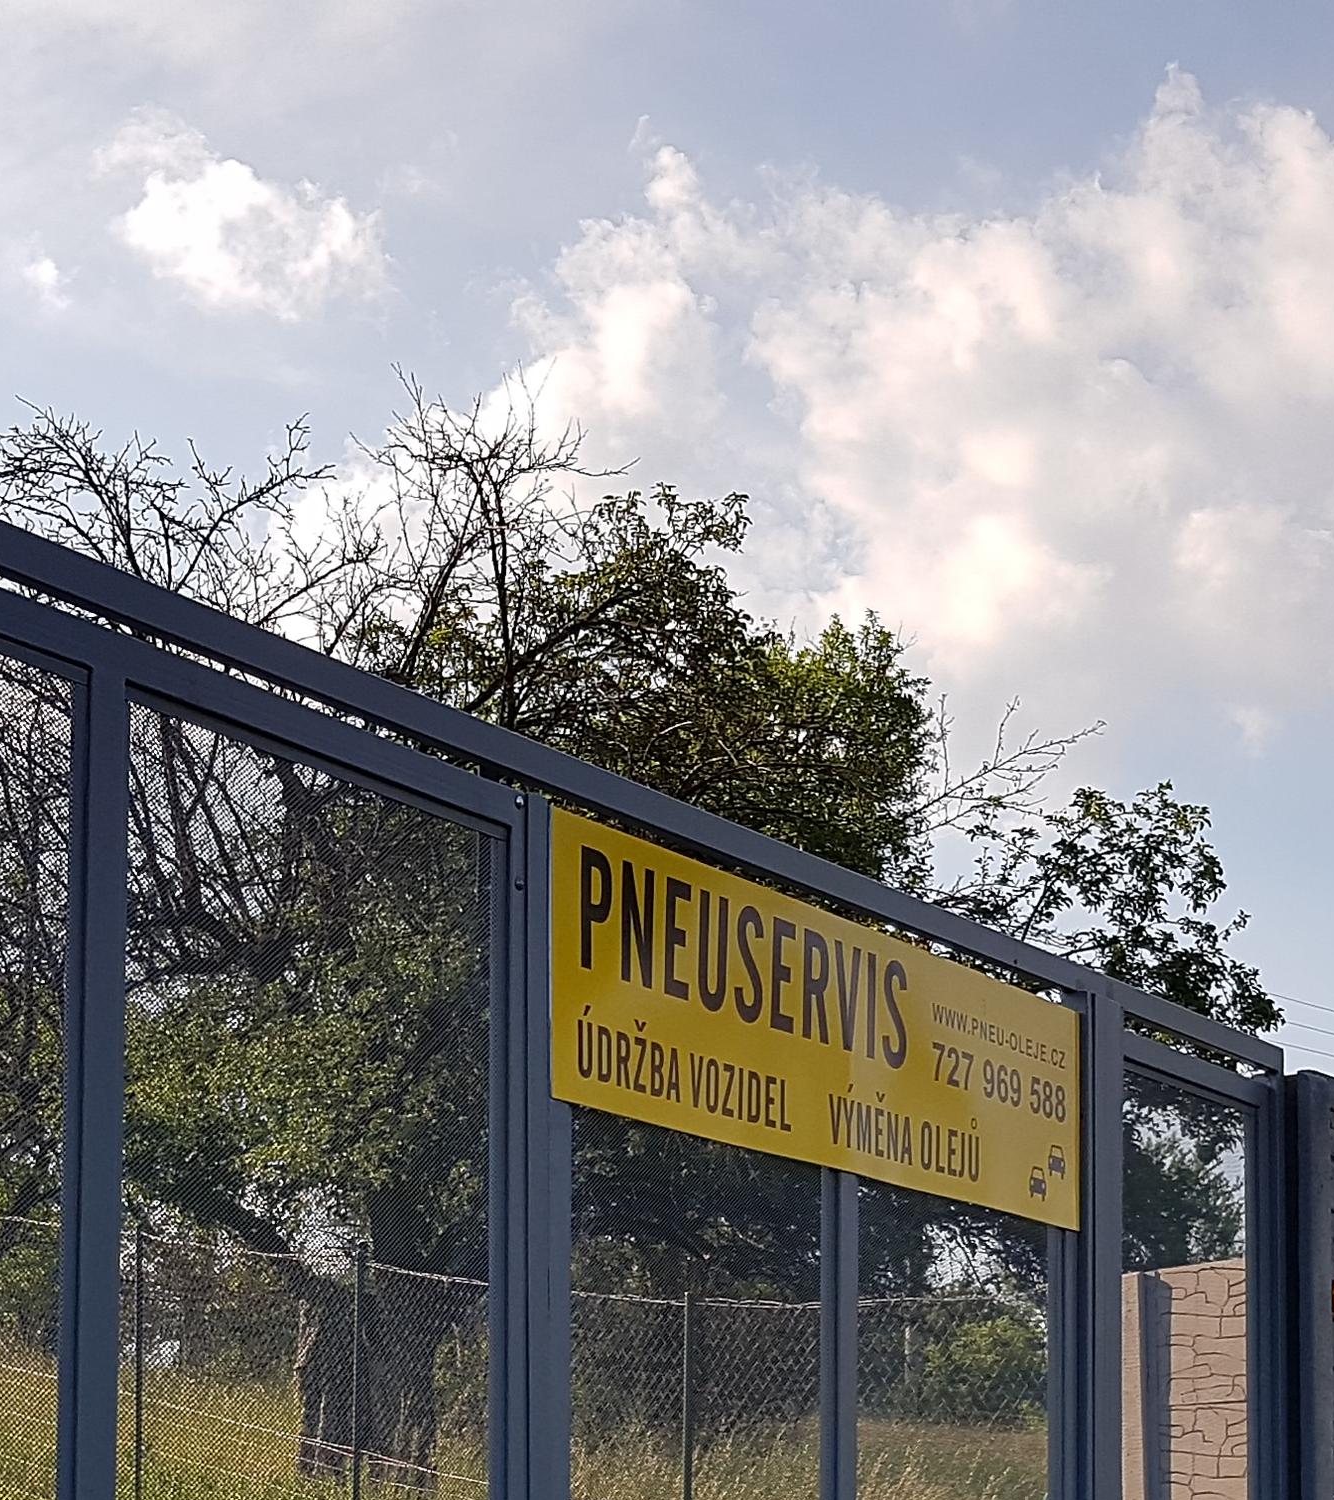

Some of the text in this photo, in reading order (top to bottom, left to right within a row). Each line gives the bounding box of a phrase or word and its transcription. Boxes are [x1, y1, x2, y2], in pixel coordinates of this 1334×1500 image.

[580, 845, 908, 1069] PNEUSERVIS
[577, 1005, 792, 1133] ÚDRŽBA VOZIDEL
[931, 1002, 1065, 1069] WWW.PNEU-OLEJE.CZ
[931, 1041, 1066, 1124] 727 969 588
[829, 1083, 980, 1183] VÝMĚNA OLEJŮ
